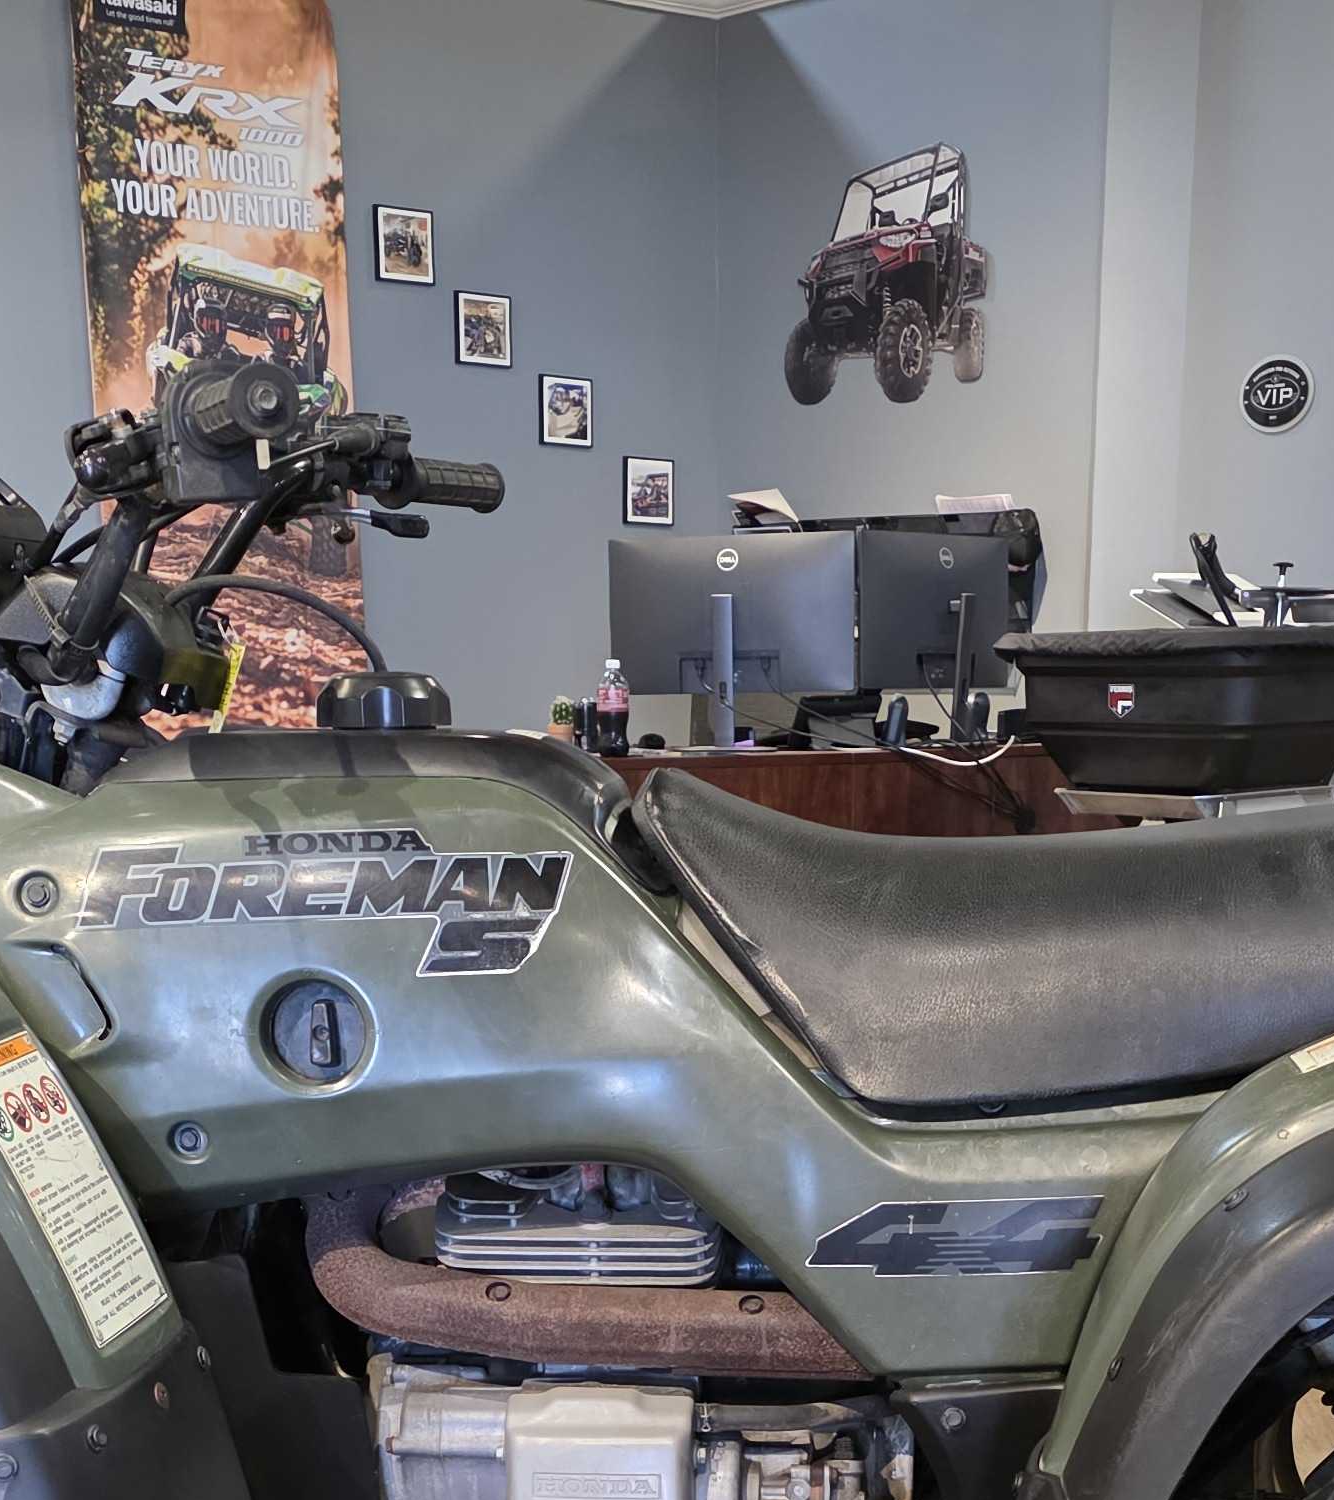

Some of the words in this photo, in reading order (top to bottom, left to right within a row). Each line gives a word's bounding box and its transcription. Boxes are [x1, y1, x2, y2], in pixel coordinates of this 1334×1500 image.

[101, 0, 177, 16] wasaki
[111, 69, 305, 128] KRX
[239, 127, 305, 147] 1000
[134, 138, 201, 180] YOUR
[207, 147, 297, 190] WORLD.
[111, 178, 178, 220] YOUR
[185, 190, 321, 233] ADVENTURE.
[1257, 387, 1293, 406] VIP
[244, 830, 430, 856] HONDA
[76, 844, 573, 930] FOREMAN
[536, 1475, 658, 1498] HONDA
